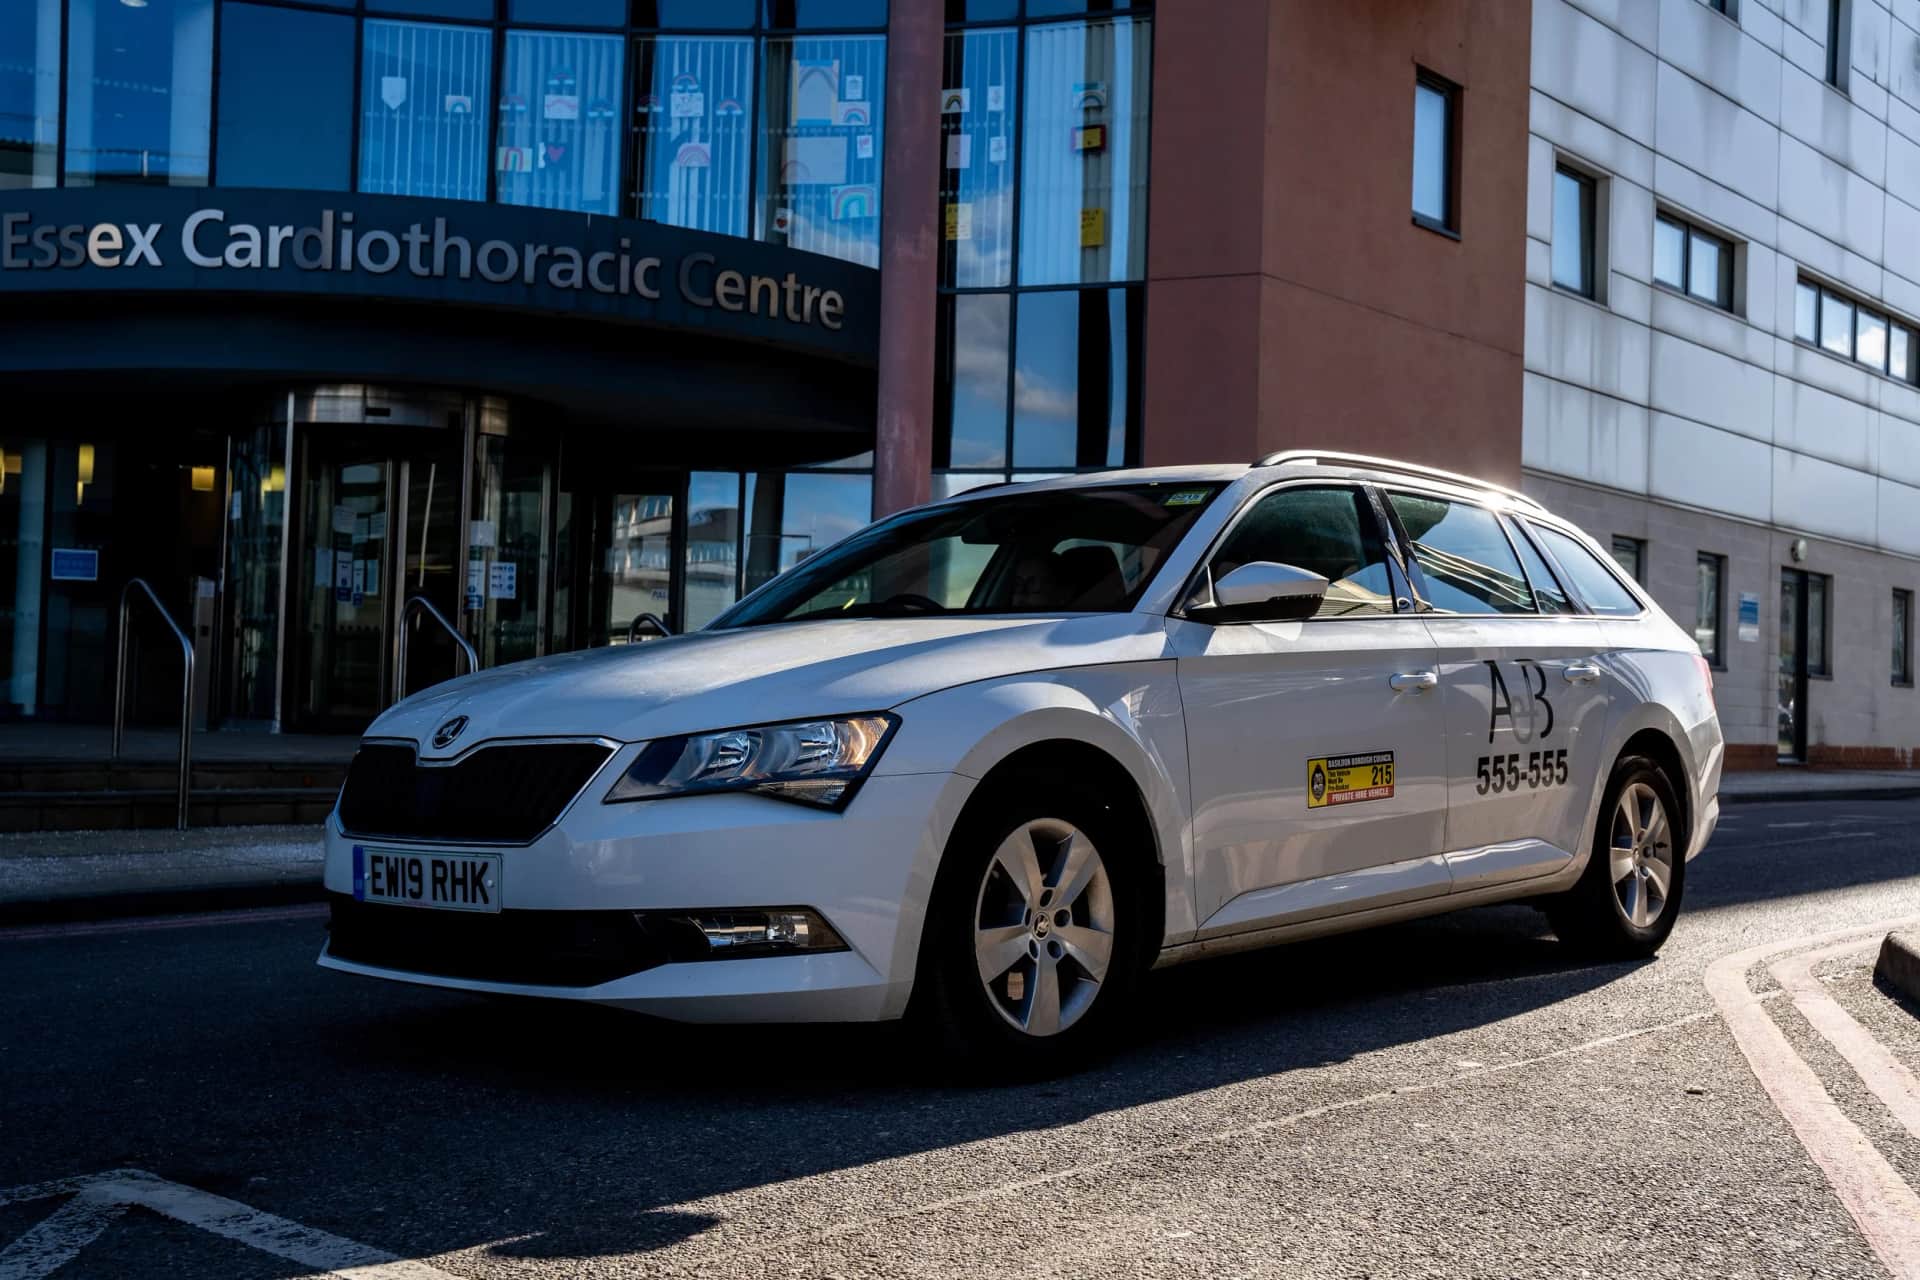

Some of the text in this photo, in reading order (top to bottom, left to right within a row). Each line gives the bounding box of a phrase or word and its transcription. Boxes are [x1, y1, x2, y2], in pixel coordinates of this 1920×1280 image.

[2, 208, 845, 330] Essex Cardiothoracic Centre
[1332, 787, 1389, 802] PRIVATE HIRE VEHICLE
[1372, 765, 1392, 785] 215
[1476, 749, 1568, 795] 555-555
[371, 855, 489, 904] EW19 RHK
